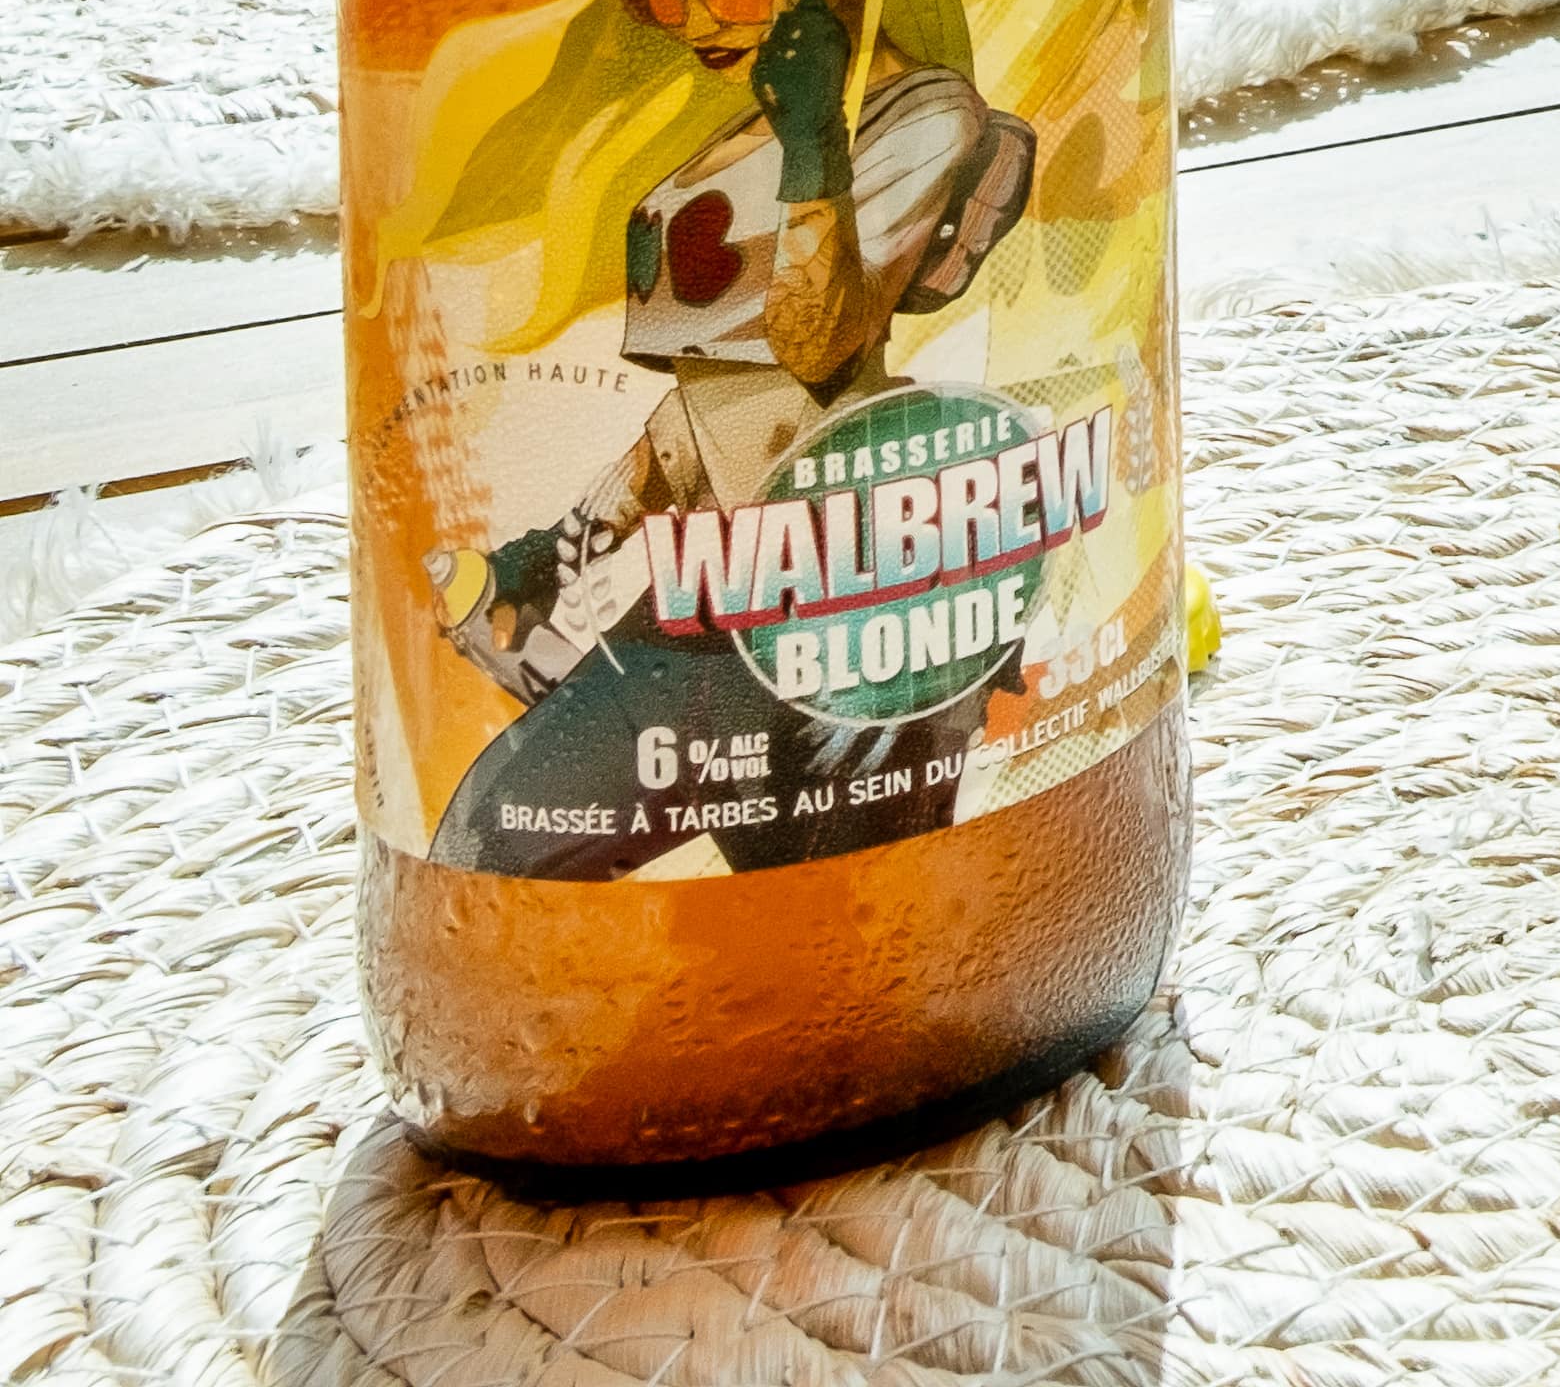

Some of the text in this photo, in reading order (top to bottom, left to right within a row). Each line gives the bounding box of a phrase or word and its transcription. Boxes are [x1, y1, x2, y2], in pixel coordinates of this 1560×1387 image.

[528, 362, 629, 394] HAUTE
[793, 409, 1014, 490] BRASSERIE
[643, 404, 1113, 638] WALBREW
[775, 573, 1026, 702] BLONDE
[500, 802, 617, 835] BRASSÉE
[629, 802, 652, 834] À
[665, 797, 778, 832] TARBES
[793, 784, 835, 817] AU
[848, 768, 913, 807] SEIN
[926, 751, 964, 787] DU
[976, 698, 1091, 771] COLLECTIF
[729, 730, 770, 758] ALC
[730, 753, 772, 780] VOL
